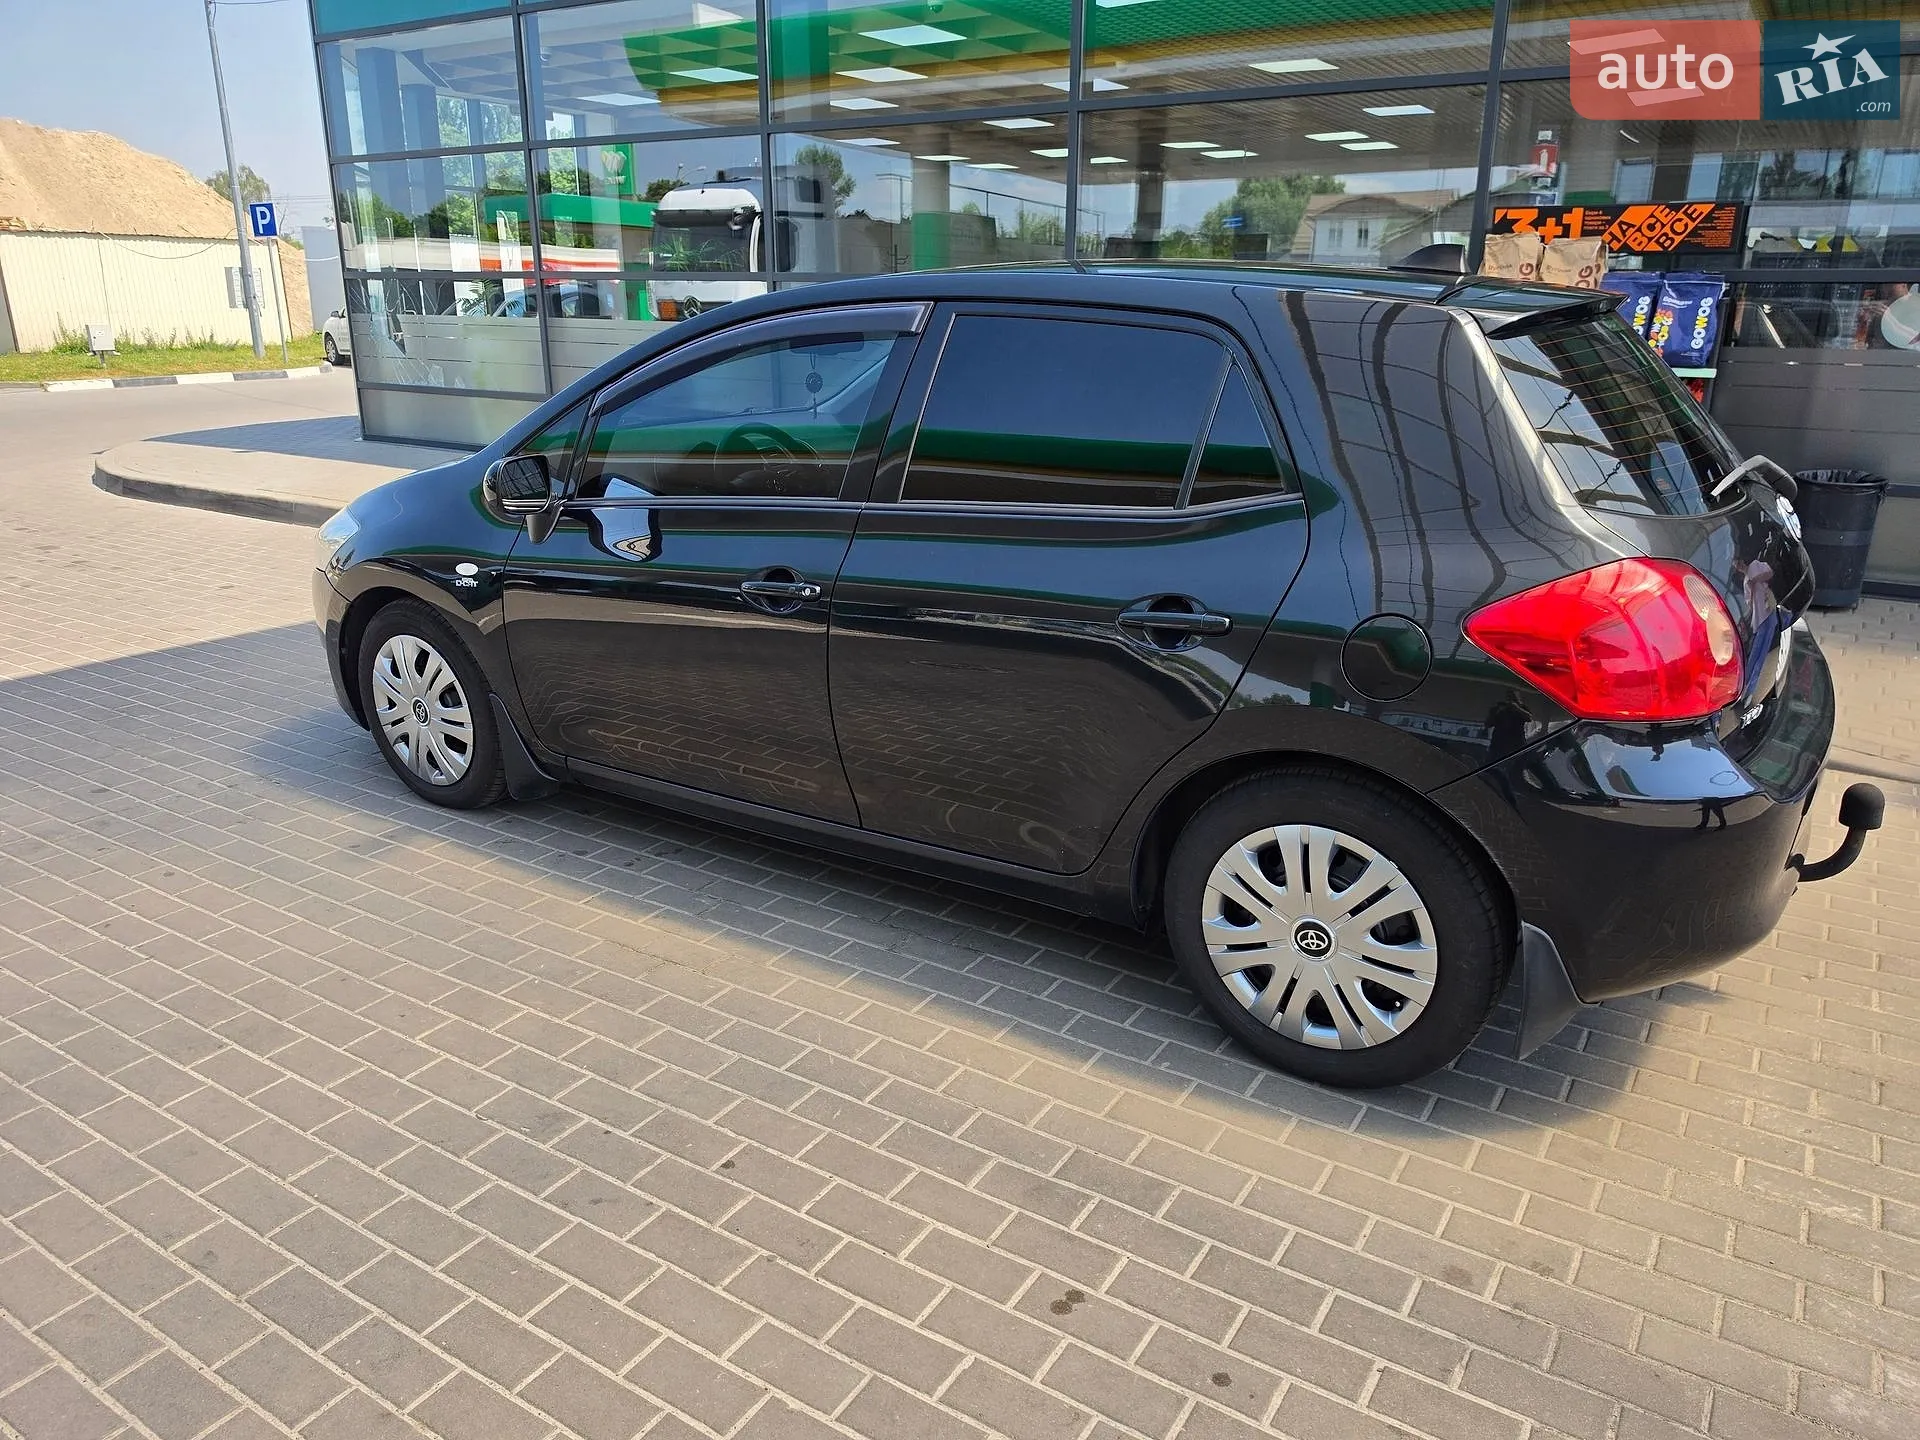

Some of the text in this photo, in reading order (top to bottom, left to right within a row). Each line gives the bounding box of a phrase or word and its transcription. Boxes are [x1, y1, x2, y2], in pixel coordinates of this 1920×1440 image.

[255, 206, 271, 234] P
[1626, 204, 1676, 251] ВСЕ
[1654, 204, 1704, 250] ВСЕ
